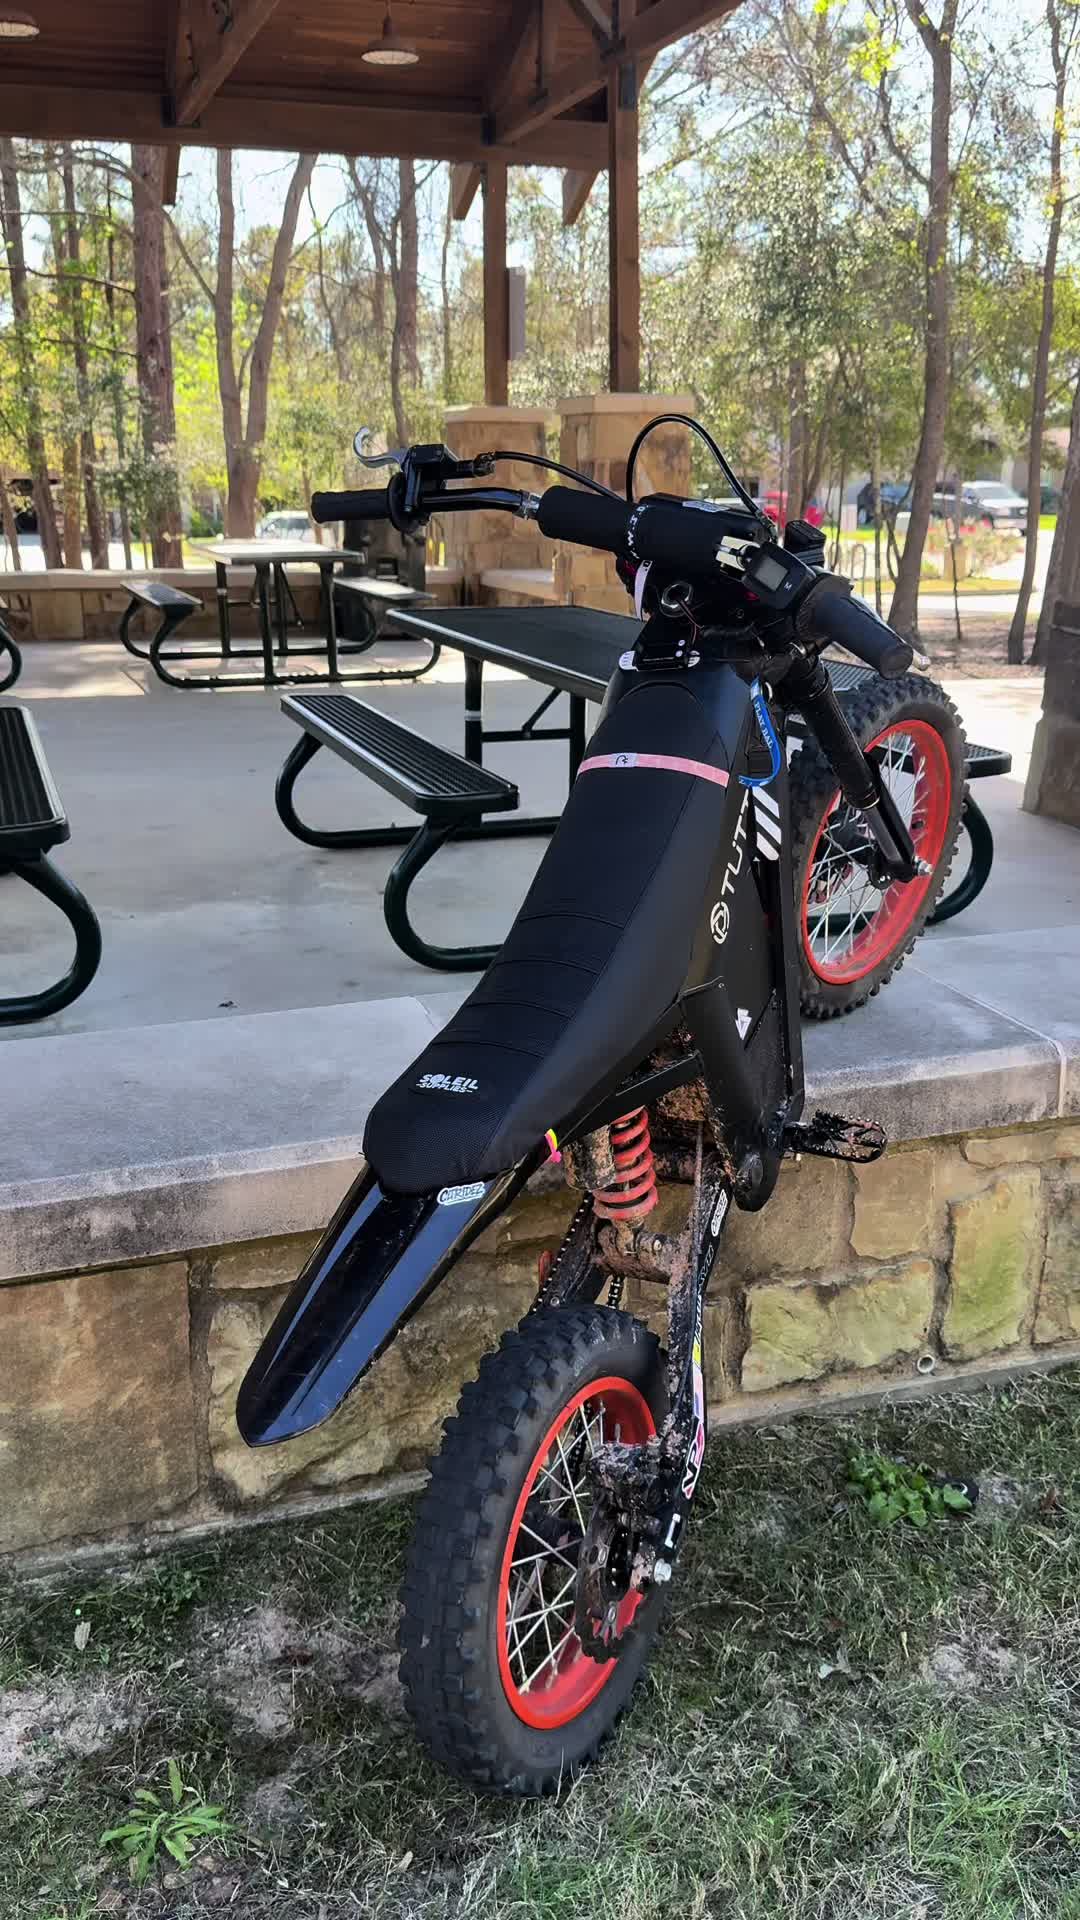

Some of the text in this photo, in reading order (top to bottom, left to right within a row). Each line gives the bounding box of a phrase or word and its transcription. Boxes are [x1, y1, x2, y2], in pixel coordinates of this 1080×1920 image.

[754, 702, 774, 751] PLAY BAL
[419, 1074, 479, 1090] SOLEIL
